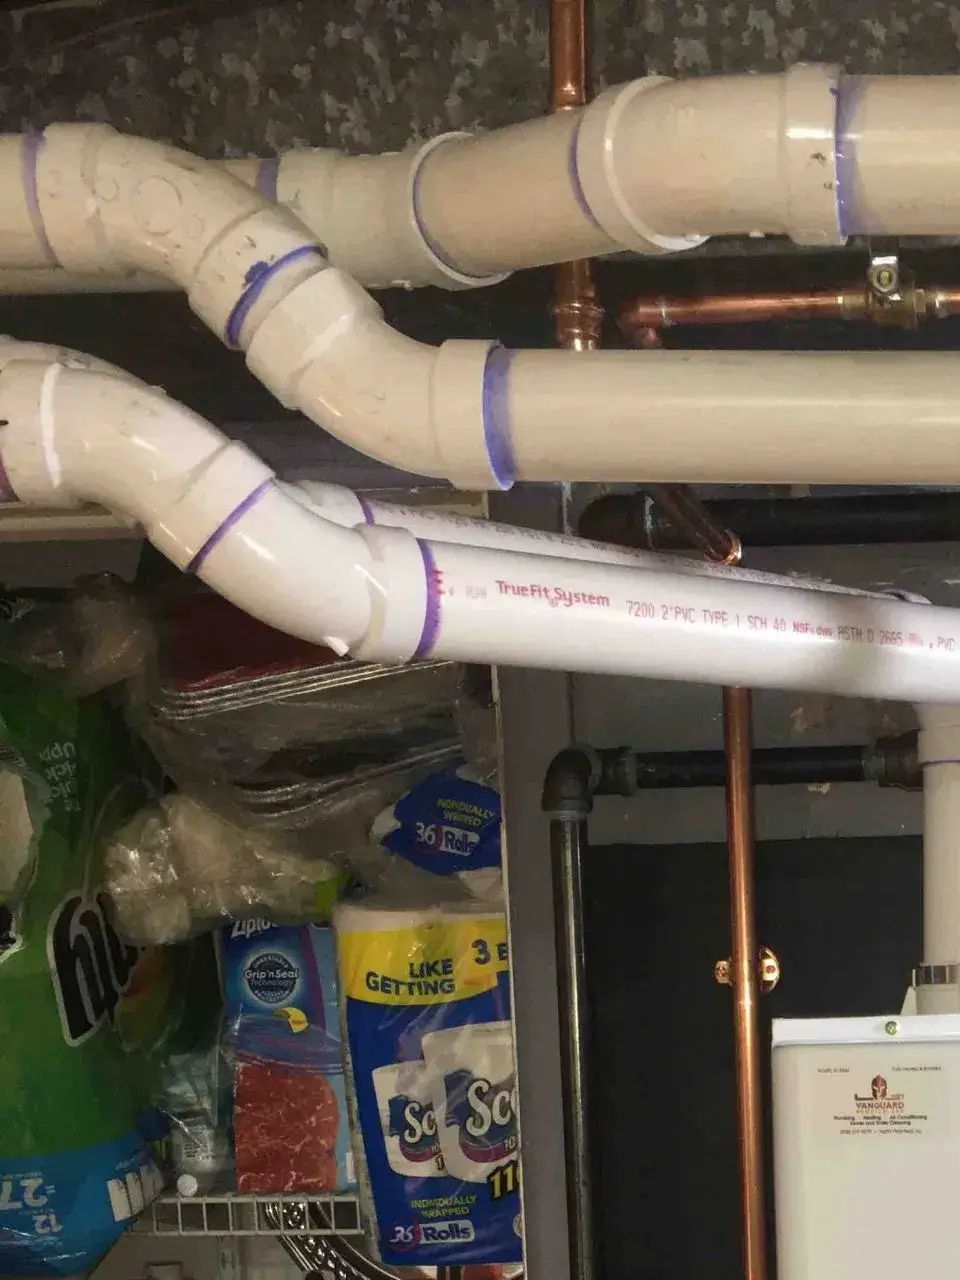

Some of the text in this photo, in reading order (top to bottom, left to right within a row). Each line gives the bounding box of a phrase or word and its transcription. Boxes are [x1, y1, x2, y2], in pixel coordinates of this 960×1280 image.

[494, 580, 549, 602] TrueFit
[554, 587, 611, 608] System
[625, 600, 656, 619] 7200
[702, 608, 729, 628] TYPE
[772, 618, 787, 633] 40
[415, 821, 437, 846] 36
[472, 939, 491, 966] 3
[275, 968, 299, 979] Seal
[408, 958, 455, 980] LIKE
[365, 970, 456, 997] GETTING
[466, 1079, 516, 1138] Sc
[855, 1101, 905, 1110] VANGUARD
[390, 1222, 472, 1243] 36 Rolls
